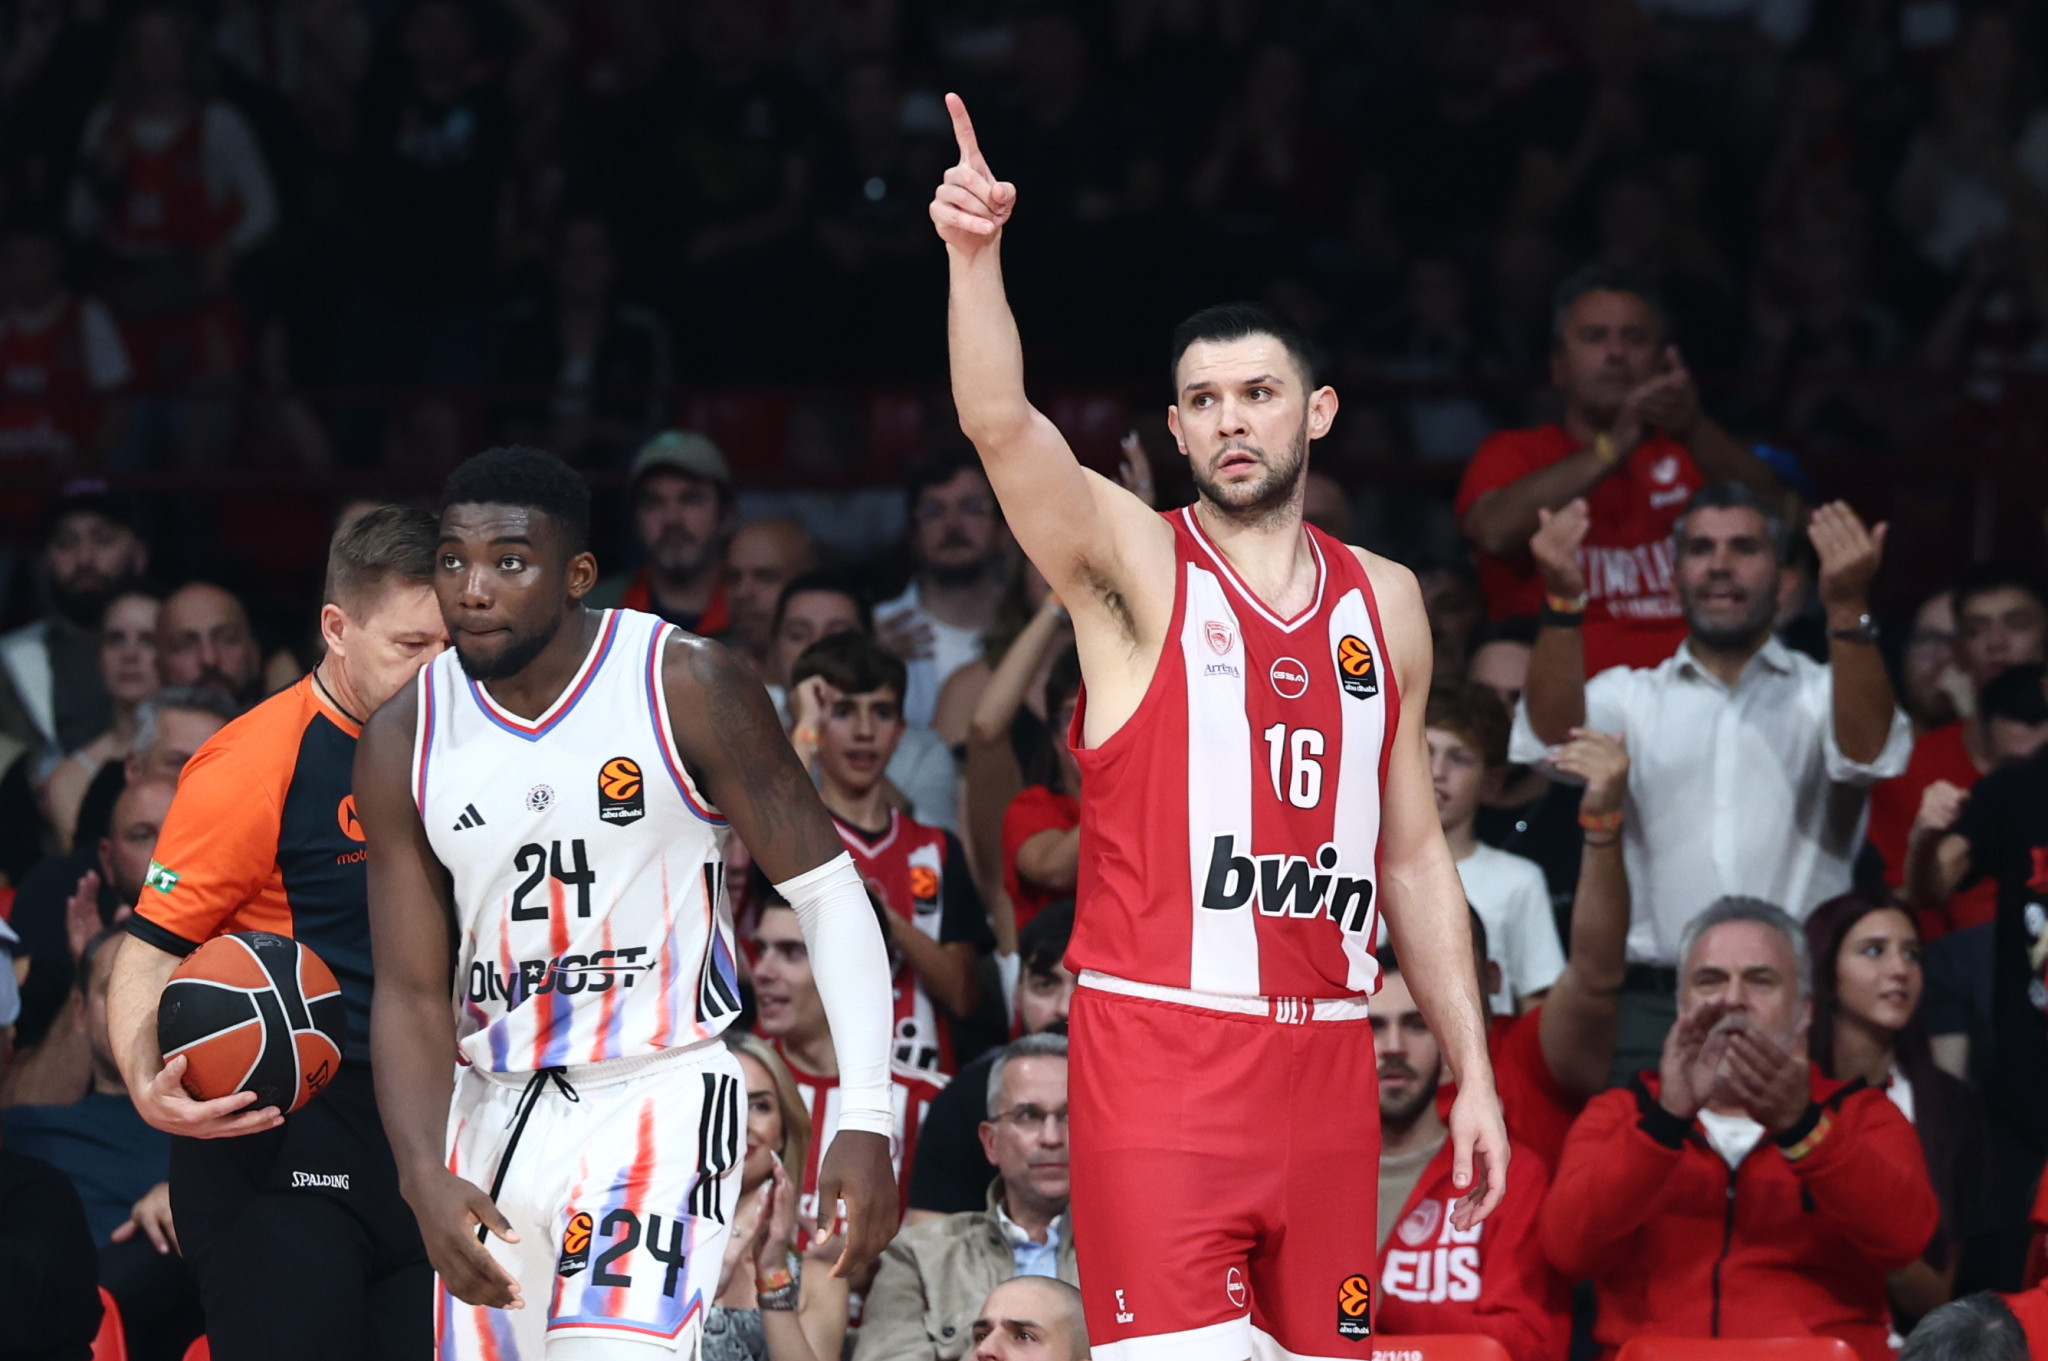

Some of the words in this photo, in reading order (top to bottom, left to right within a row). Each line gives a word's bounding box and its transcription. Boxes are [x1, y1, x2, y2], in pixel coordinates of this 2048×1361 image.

[1273, 671, 1305, 683] GSA
[1264, 722, 1326, 810] 16
[511, 838, 596, 922] 24
[1201, 834, 1374, 932] bwin
[291, 1171, 350, 1190] SPALDING
[591, 1208, 686, 1298] 24
